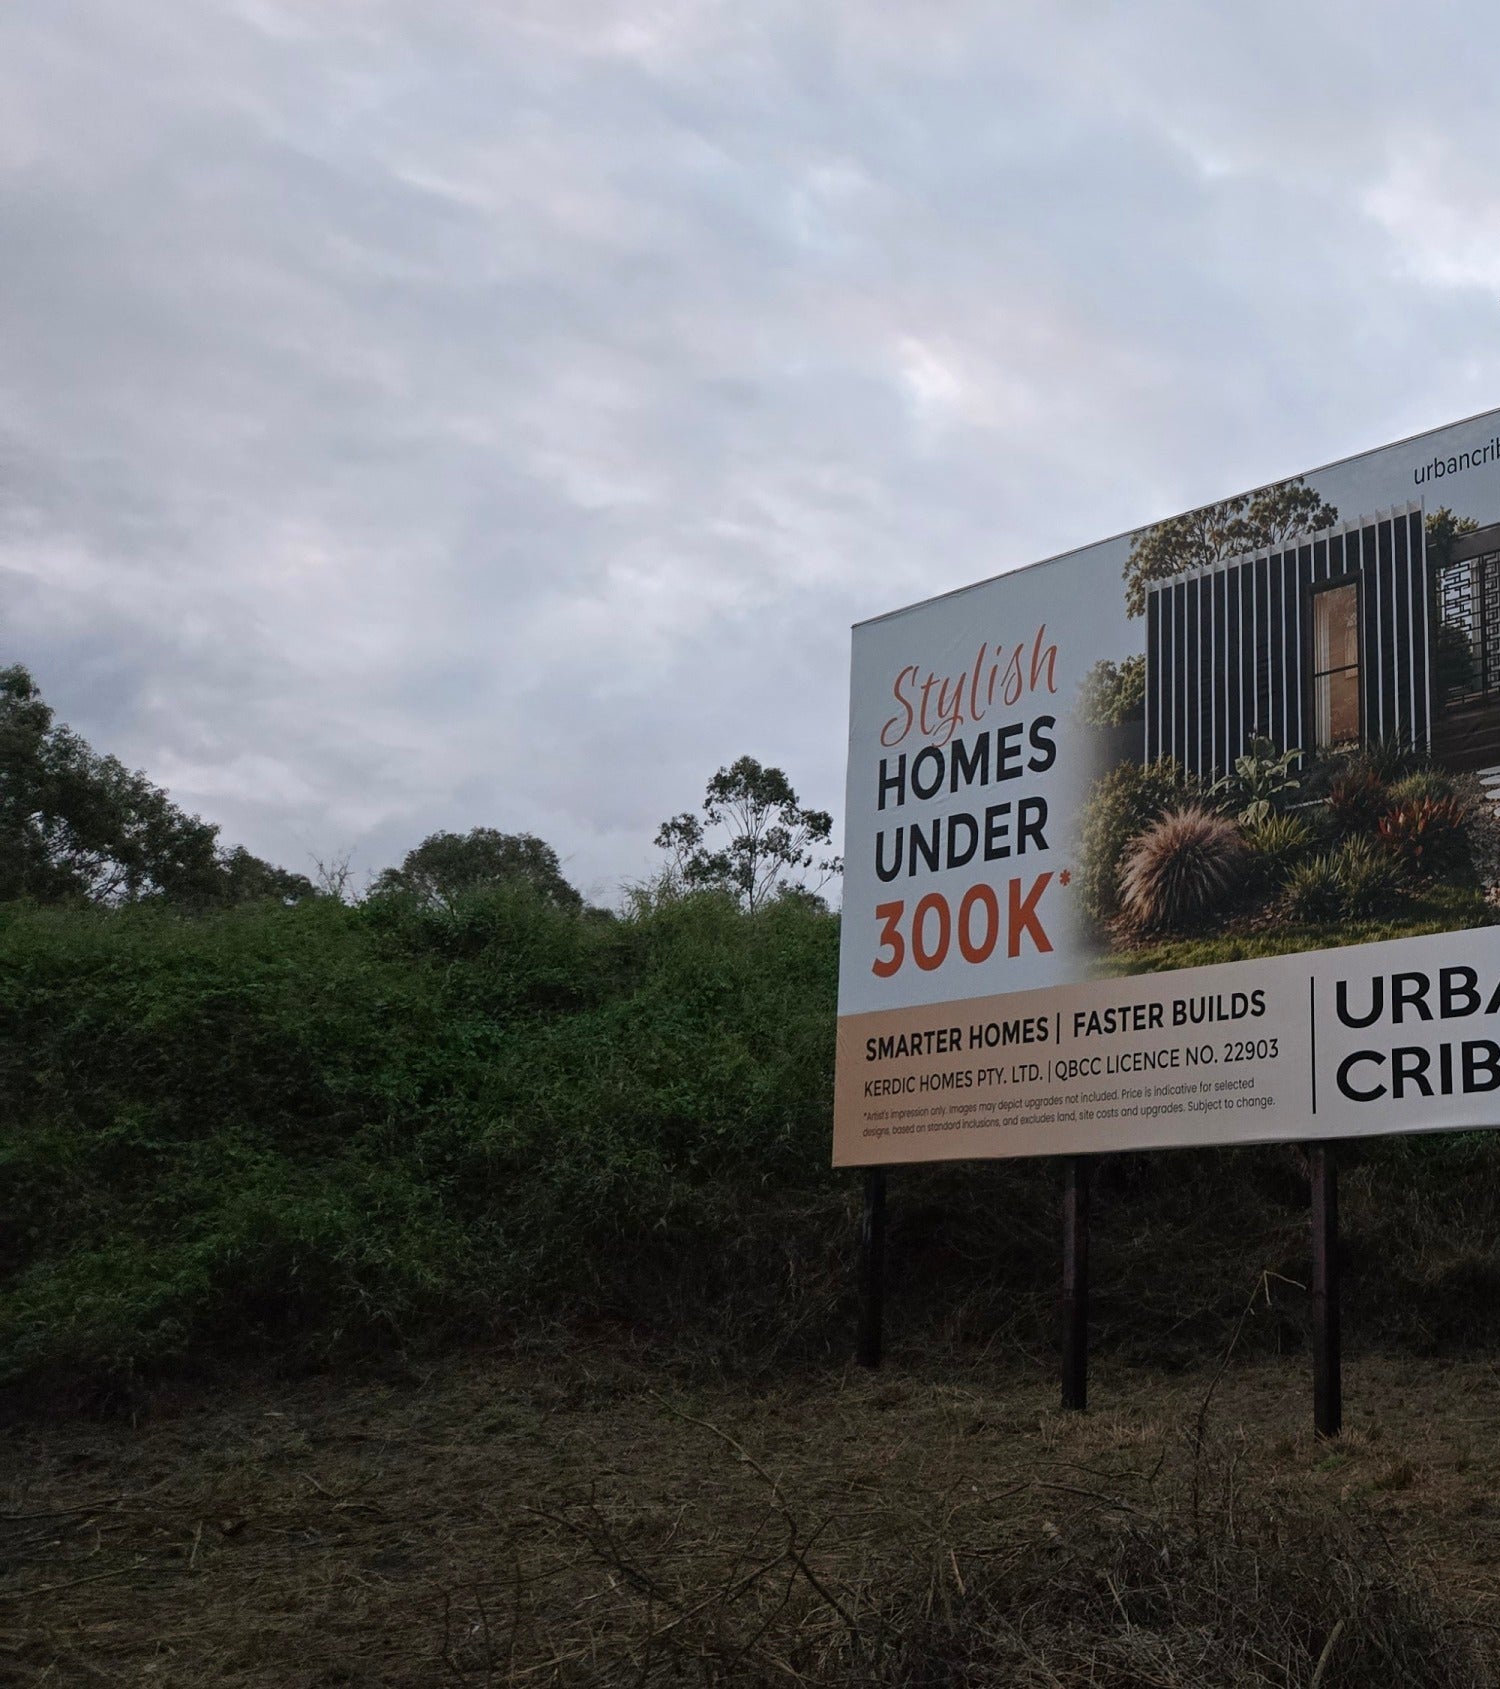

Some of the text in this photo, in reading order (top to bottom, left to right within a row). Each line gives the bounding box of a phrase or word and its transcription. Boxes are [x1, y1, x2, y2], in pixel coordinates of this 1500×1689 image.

[880, 623, 1058, 749] Stylish
[877, 715, 1057, 811] HOMES
[875, 796, 1049, 883] UNDER
[866, 989, 1266, 1061] SMARTER HOMES FASTER BUILDS
[864, 1038, 1279, 1097] KERDIC HOMES PTY. LTD. QBCC LICENCE NO. 22903
[890, 1107, 929, 1120] impression
[949, 1103, 977, 1116] Images
[979, 1102, 997, 1113] may
[998, 1099, 1023, 1112] depict
[1024, 1096, 1063, 1109] upgrades
[1065, 1092, 1079, 1104] not
[1080, 1089, 1119, 1103] included.
[1121, 1088, 1143, 1099] Price
[1145, 1086, 1152, 1097] is
[1153, 1083, 1197, 1096] indicative
[1200, 1081, 1212, 1093] for
[1214, 1077, 1255, 1091] selected
[892, 1123, 915, 1134] based
[916, 1123, 926, 1133] on
[927, 1118, 961, 1132] standard
[1002, 1114, 1018, 1126] and
[1020, 1110, 1055, 1125] excludes
[1079, 1107, 1094, 1120] site
[1096, 1106, 1119, 1119] costs
[1121, 1104, 1138, 1116] and
[1140, 1101, 1185, 1117] upgrades.
[1187, 1097, 1222, 1114] Subject
[1224, 1097, 1234, 1108] to
[1236, 1094, 1276, 1110] change.
